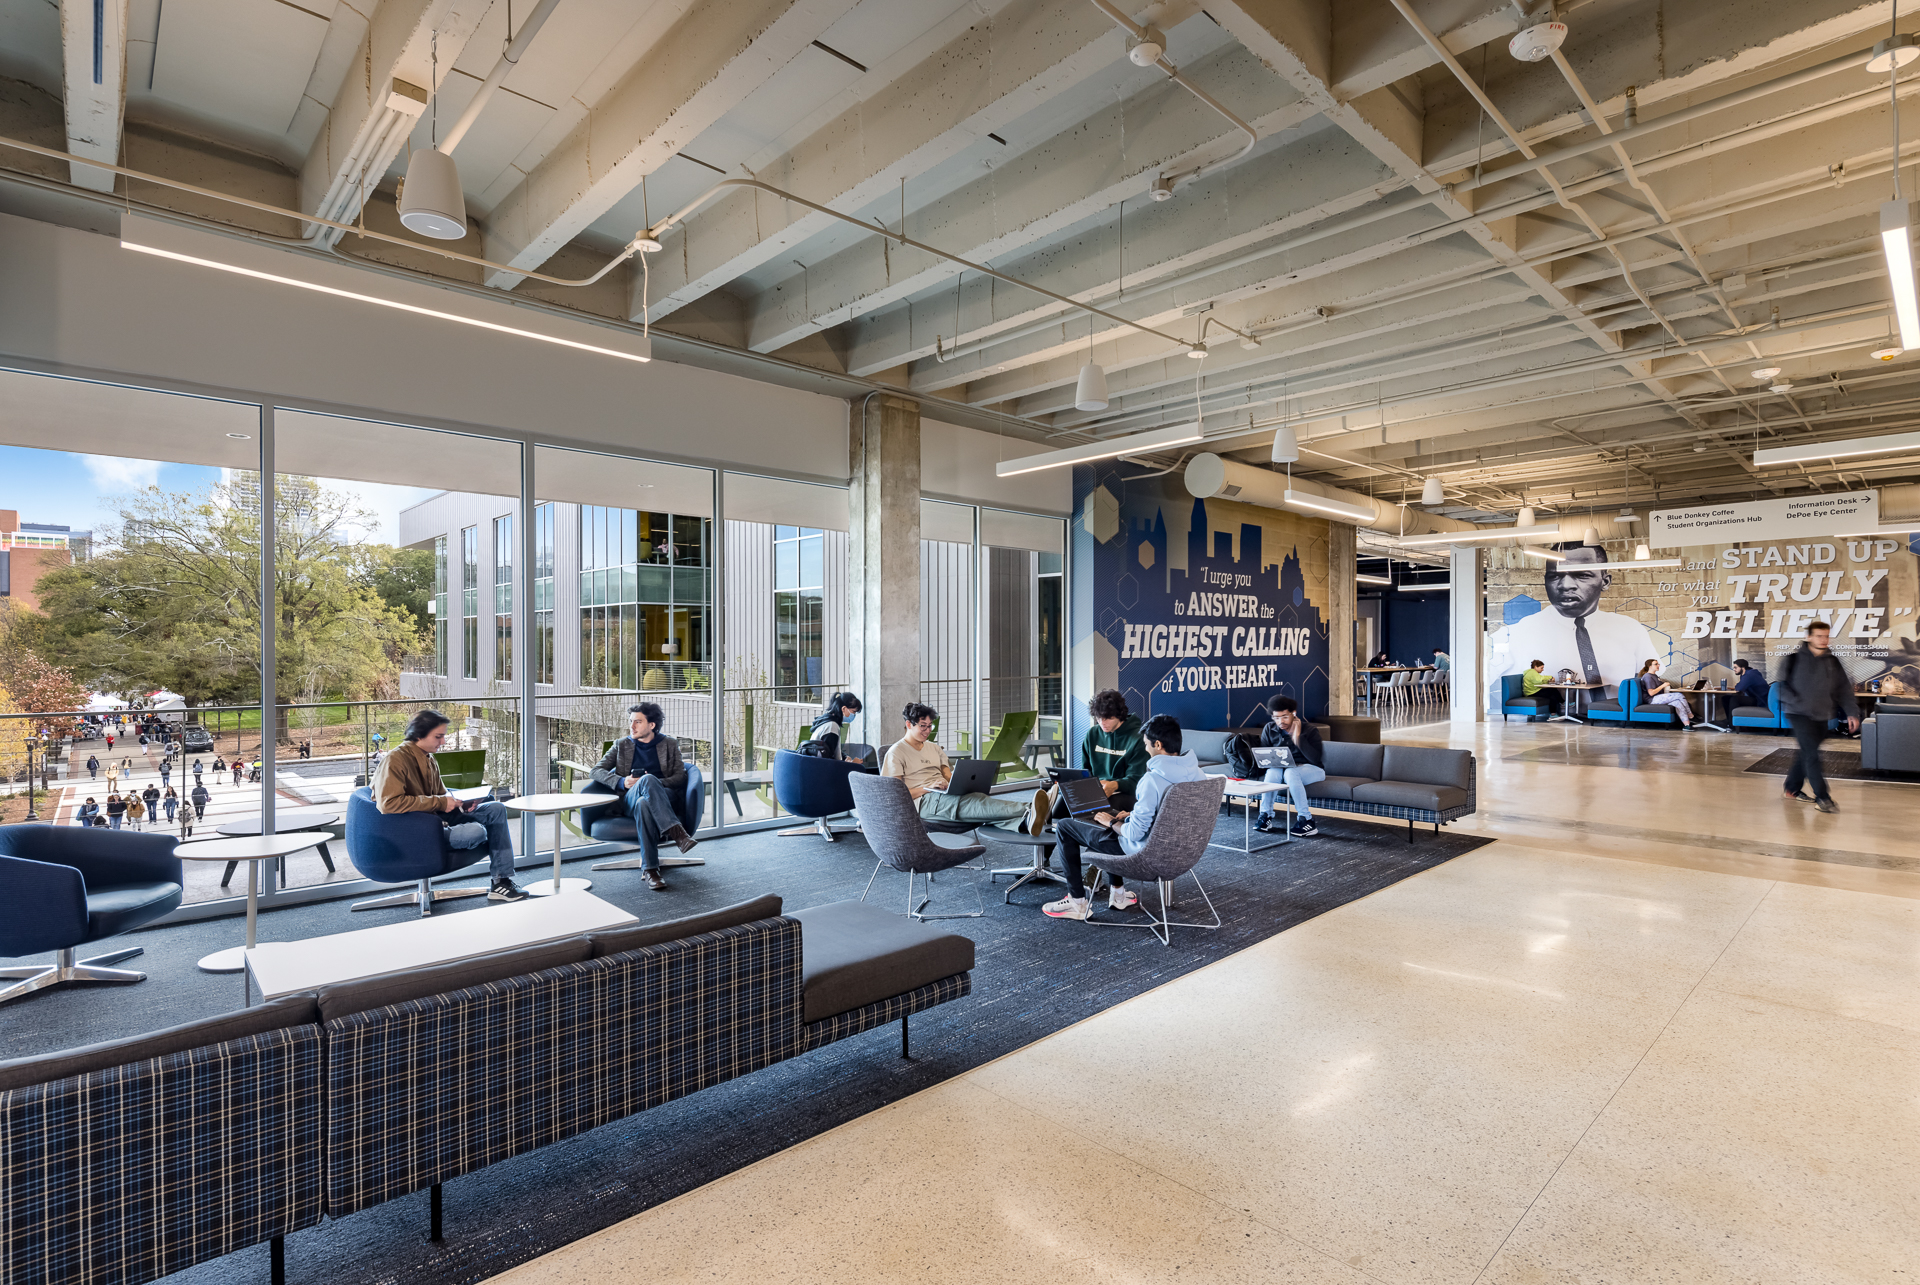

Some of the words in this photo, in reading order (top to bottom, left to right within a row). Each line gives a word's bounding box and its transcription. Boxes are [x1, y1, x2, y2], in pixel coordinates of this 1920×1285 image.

[1549, 23, 1565, 31] FIRE
[1788, 500, 1835, 510] Information
[1837, 497, 1858, 505] Desk
[1684, 511, 1710, 519] Donkey
[1711, 509, 1735, 517] Coffee
[1786, 511, 1812, 519] DePoe
[1667, 520, 1694, 530] Student
[1695, 517, 1745, 528] Organizations
[1675, 557, 1717, 572] ...and
[1721, 542, 1836, 569] STAND
[1846, 539, 1899, 563] UP
[1210, 571, 1233, 589] urge
[1234, 573, 1252, 589] you
[1657, 580, 1679, 593] for
[1682, 578, 1721, 592] what
[1725, 568, 1889, 604] TRULY
[1174, 599, 1185, 616] to
[1186, 591, 1259, 618] ANSWER
[1260, 604, 1275, 619] the
[1689, 593, 1718, 608] you
[1121, 624, 1228, 659] HIGHEST
[1231, 627, 1311, 657] CALLING
[1161, 675, 1174, 693] of
[1174, 666, 1222, 692] YOUR
[1225, 664, 1284, 689] HEART...
